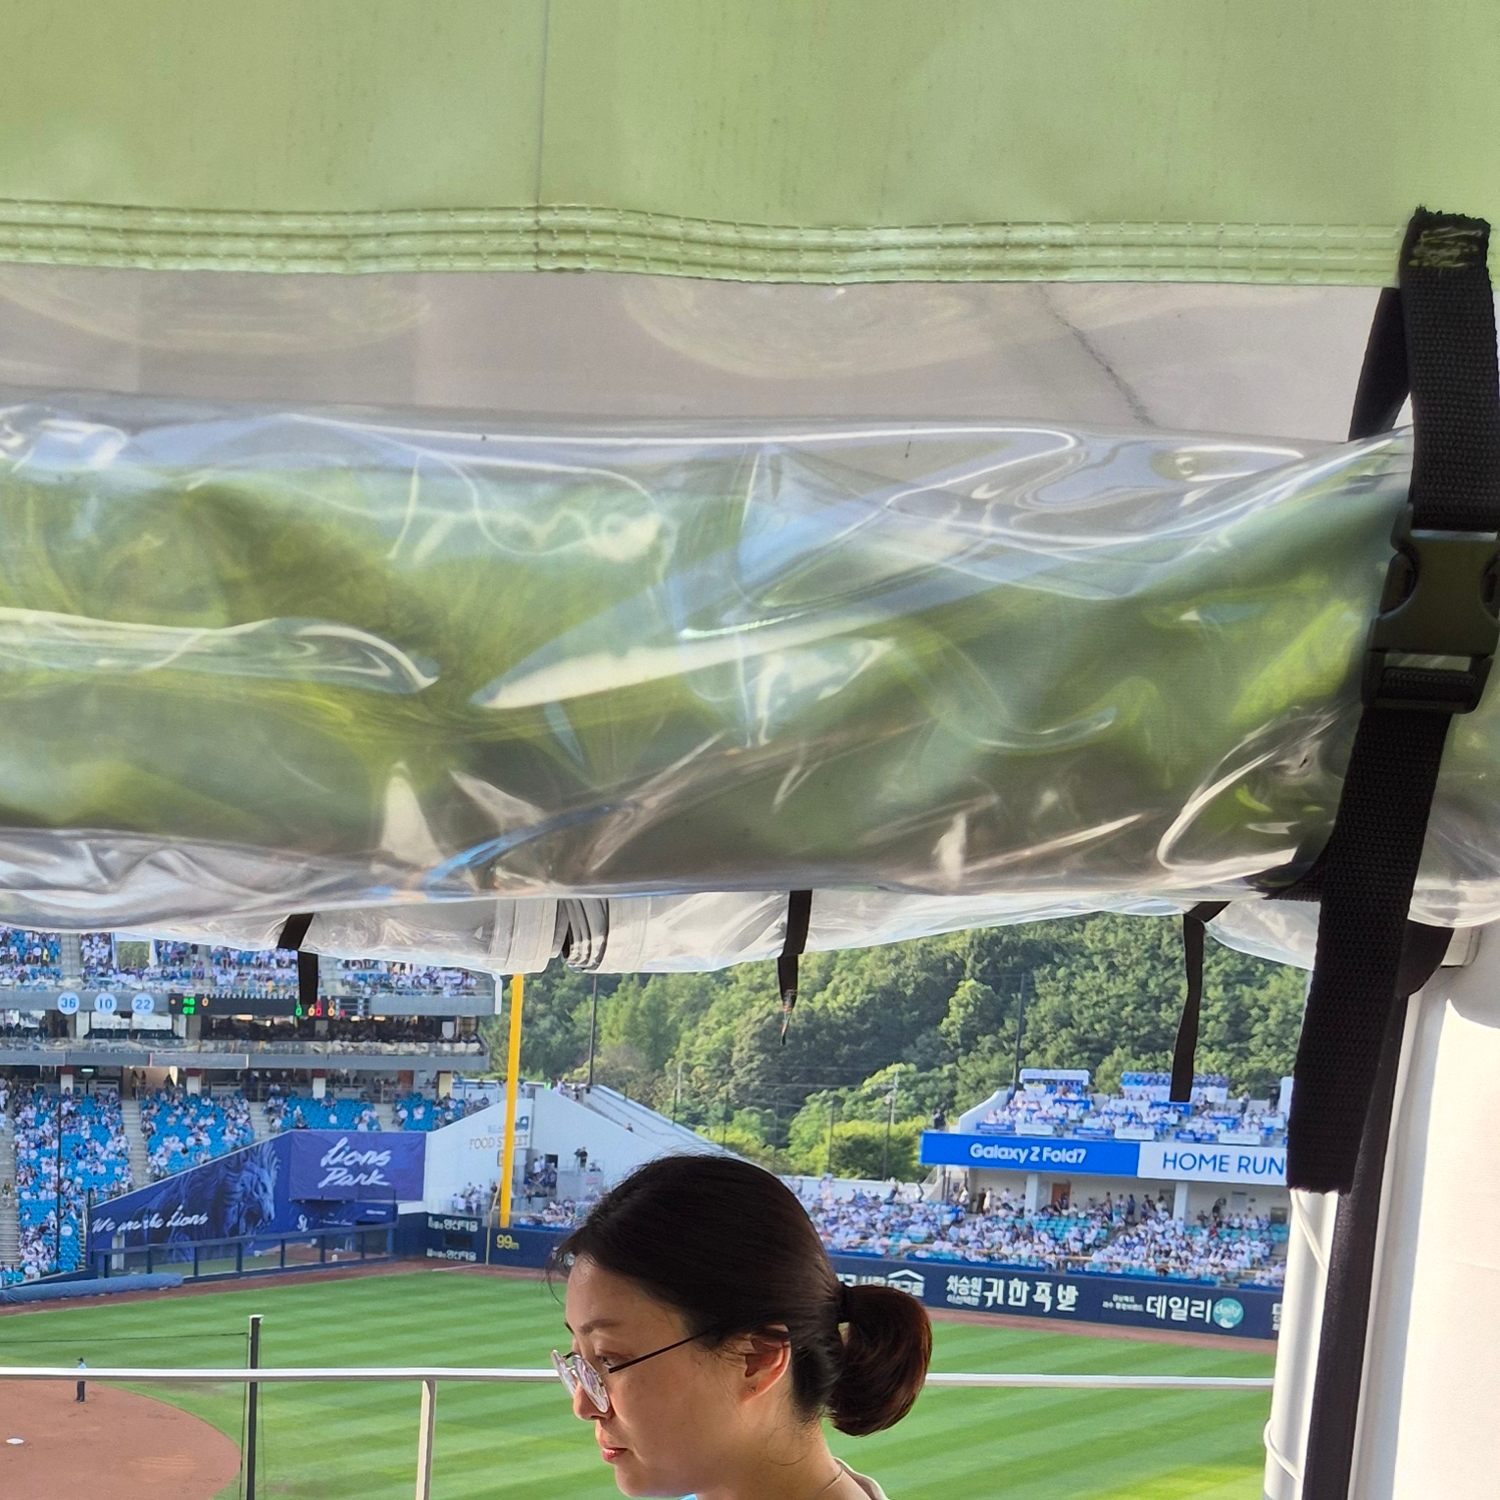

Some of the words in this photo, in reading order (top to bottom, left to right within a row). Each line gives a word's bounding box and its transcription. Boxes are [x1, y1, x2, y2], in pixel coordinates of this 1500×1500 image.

[61, 997, 77, 1009] 36
[98, 998, 113, 1010] 10
[135, 998, 150, 1010] 22
[320, 1136, 391, 1167] Lions
[970, 1143, 1029, 1164] Galaxy
[1030, 1146, 1040, 1162] Z
[1043, 1147, 1087, 1164] Fold7
[1162, 1151, 1230, 1173] HOME
[1237, 1156, 1285, 1176] RUN
[317, 1167, 391, 1189] Park
[92, 1217, 117, 1234] We
[1146, 1295, 1212, 1324] 데일리
